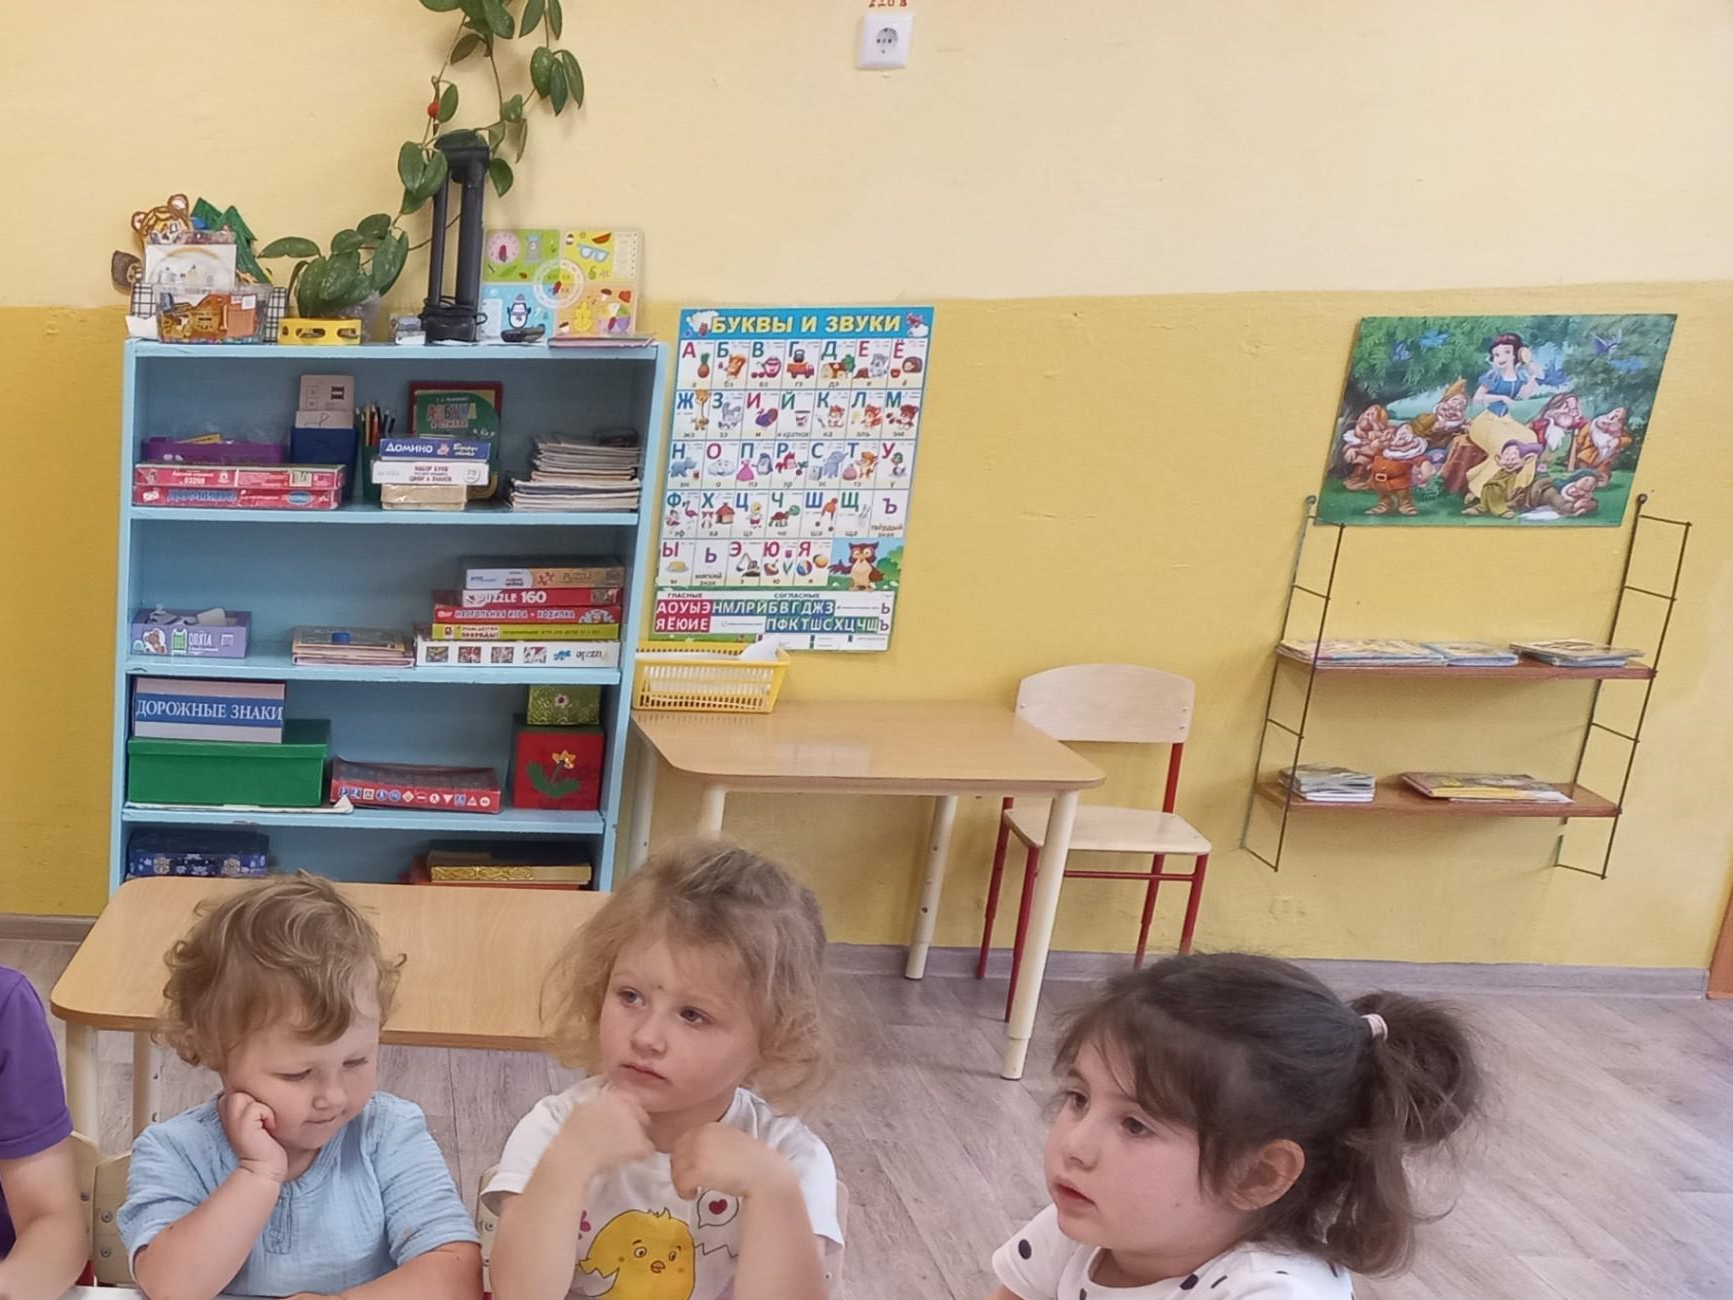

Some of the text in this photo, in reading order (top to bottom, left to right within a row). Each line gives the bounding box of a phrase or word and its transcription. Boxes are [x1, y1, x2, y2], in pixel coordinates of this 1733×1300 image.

[711, 315, 901, 334] БУКВЫ И ЗВУКИ
[682, 339, 906, 361] А Б В Г Д Е Ё
[677, 390, 902, 410] Ж З И Й К Л М
[385, 442, 433, 453] ДОМИНО
[672, 443, 896, 459] Н О П Р С Т У
[667, 492, 898, 514] Ф Х Ц Ч Ш Щ Ъ
[662, 541, 812, 563] Ы Ь Э Ю Я
[520, 590, 547, 604] 160
[135, 699, 284, 721] ДОРОЖНЫЕ ЗНАКИ
